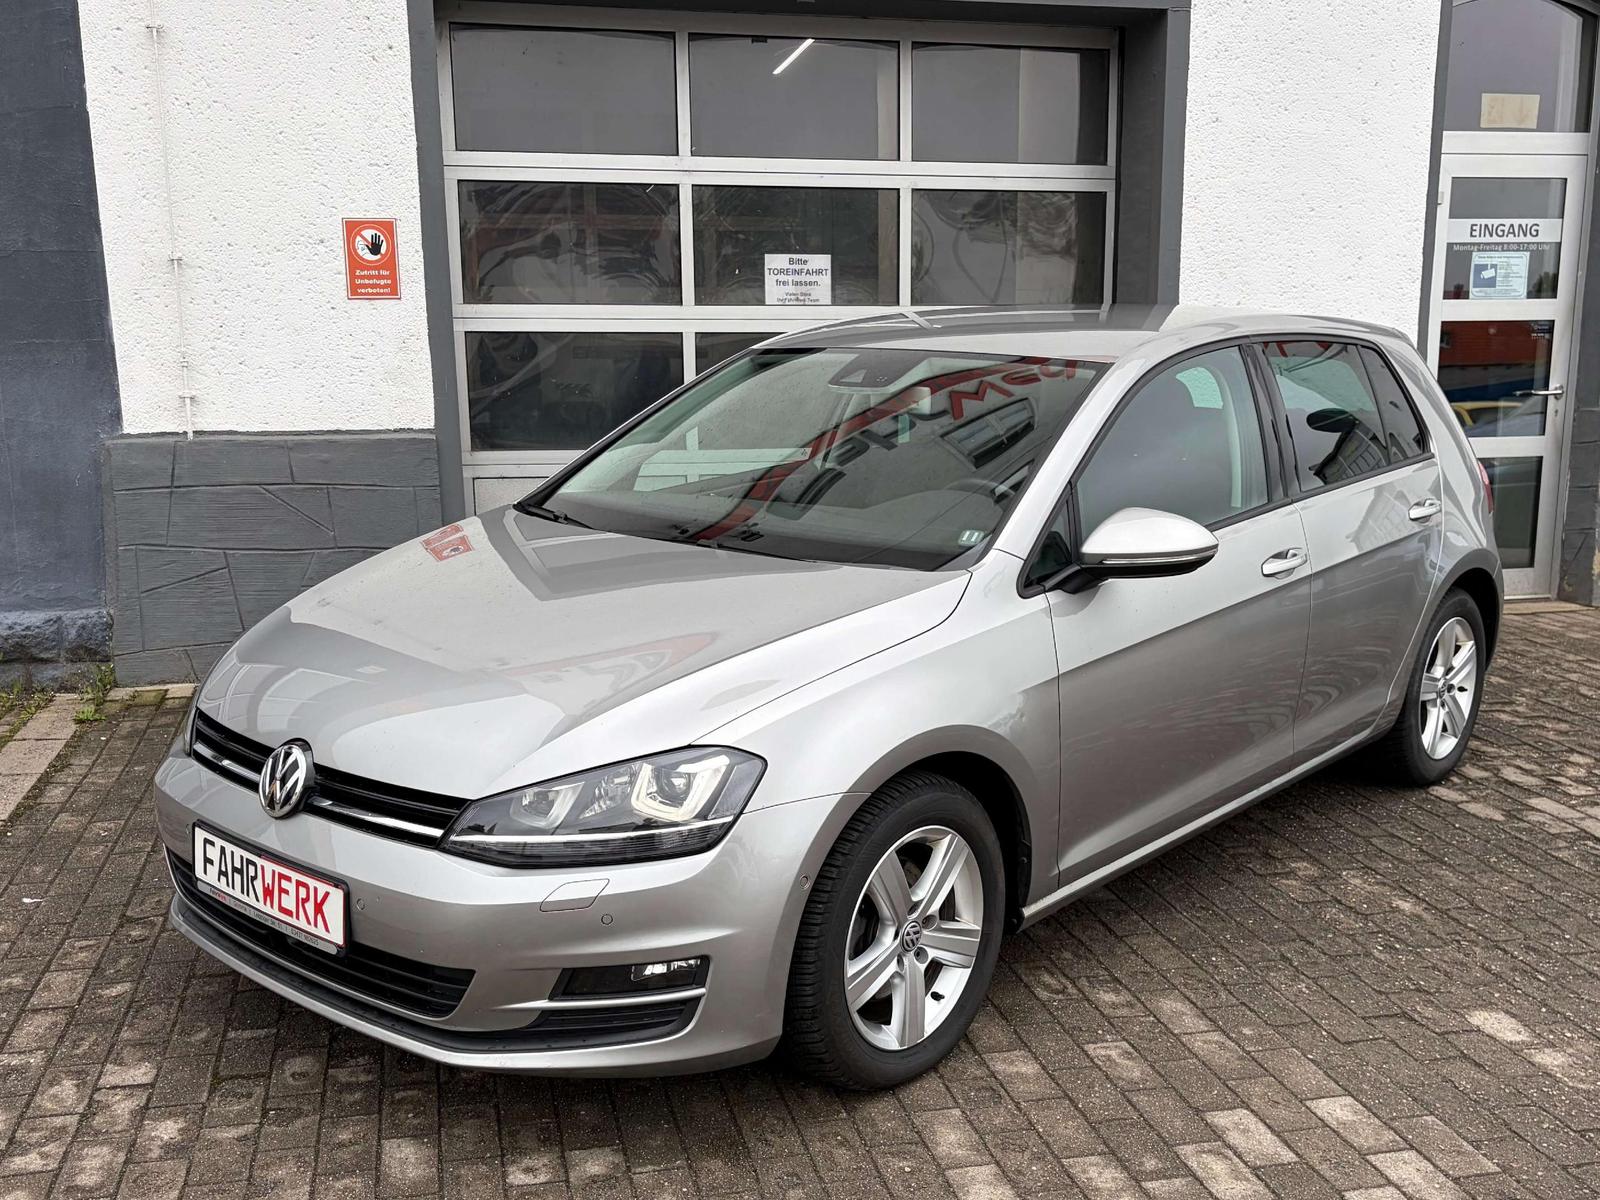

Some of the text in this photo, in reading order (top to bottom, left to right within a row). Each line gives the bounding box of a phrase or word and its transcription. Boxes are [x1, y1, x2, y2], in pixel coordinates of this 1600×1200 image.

[1469, 223, 1540, 238] EINGANG
[788, 257, 809, 265] Bitte
[767, 267, 829, 276] TOREINFAHRT
[791, 279, 821, 287] lassen.
[203, 837, 331, 934] FAHRWERK
